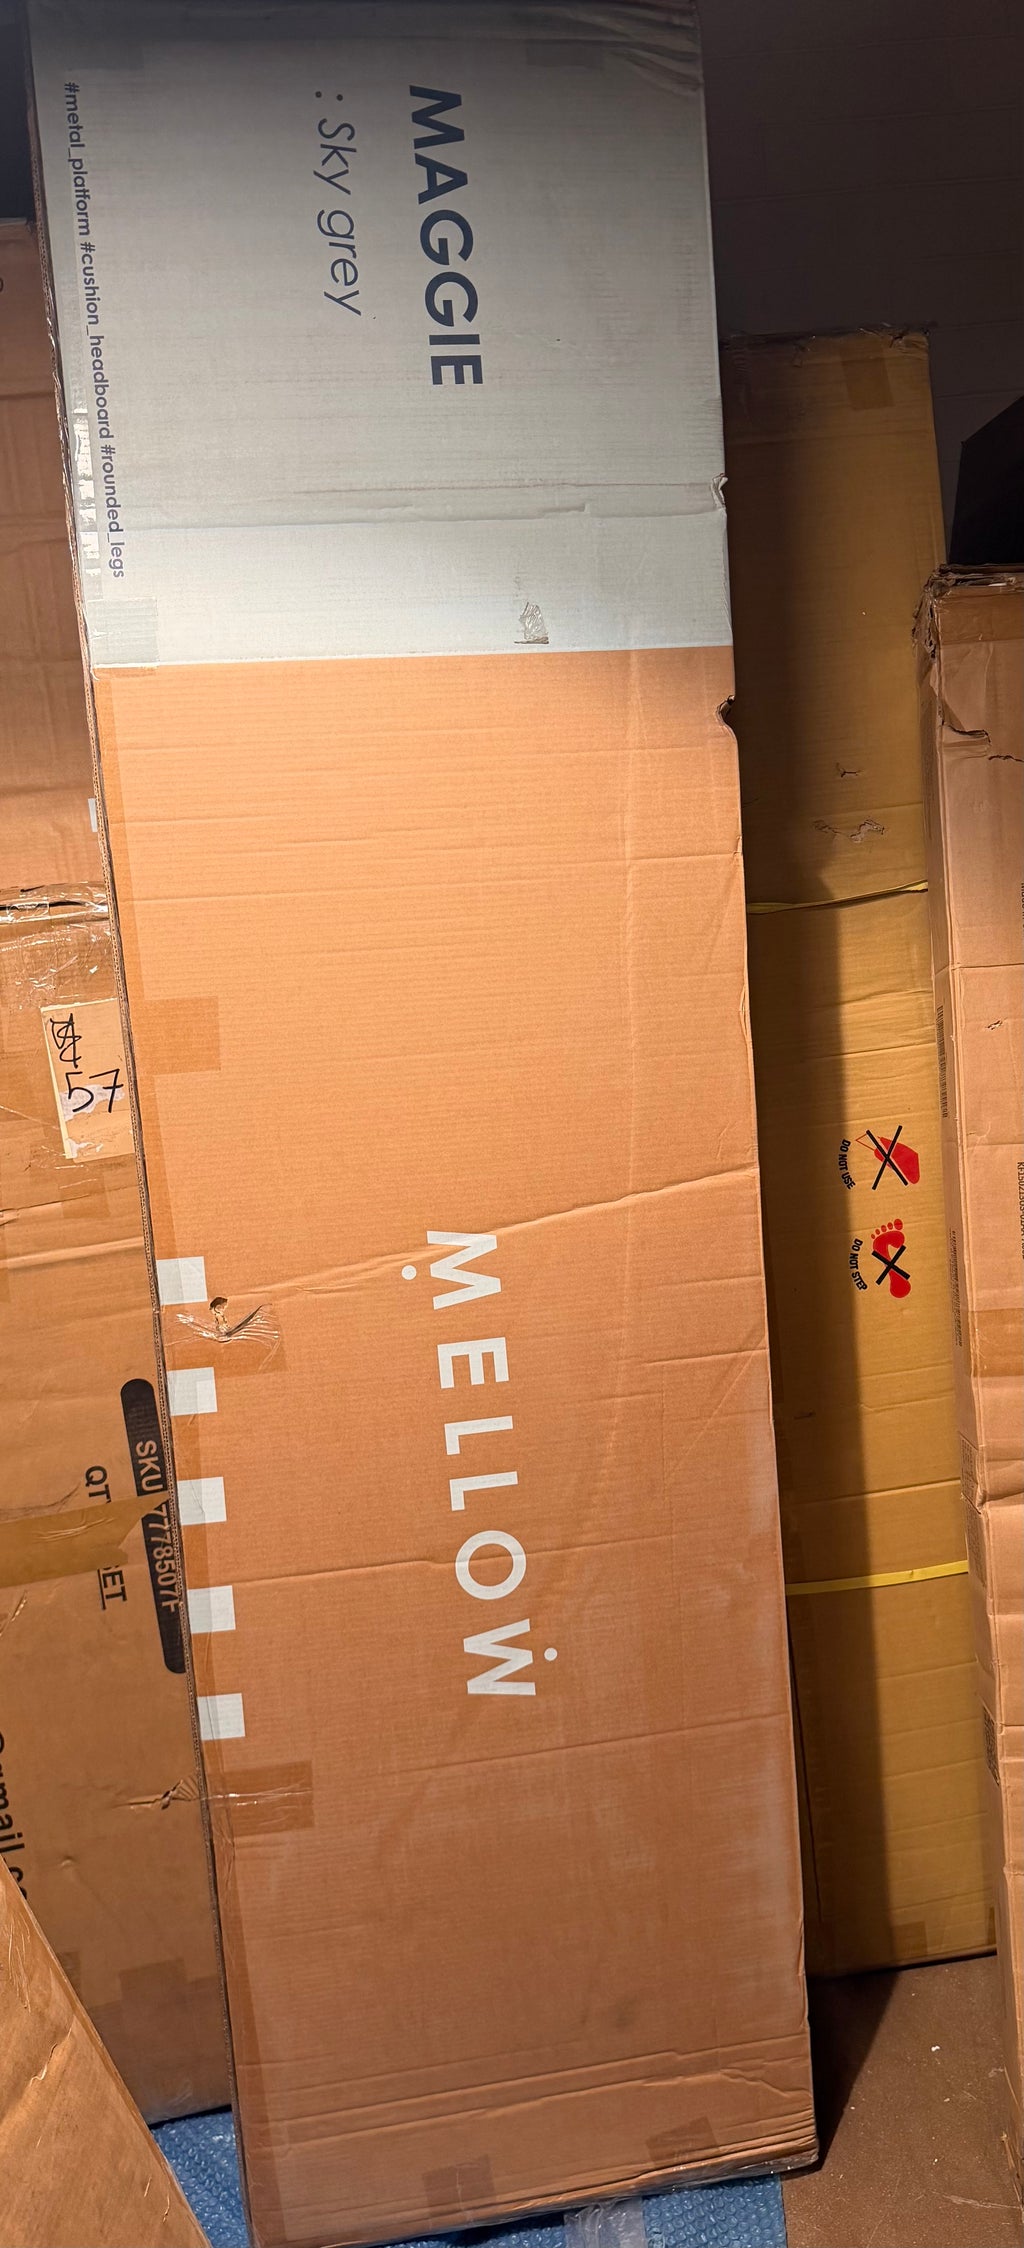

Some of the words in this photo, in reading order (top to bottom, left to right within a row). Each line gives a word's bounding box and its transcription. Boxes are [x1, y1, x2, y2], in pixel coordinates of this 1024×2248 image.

[312, 117, 358, 196] Sky
[409, 84, 484, 386] MAGGIE
[316, 209, 362, 316] grey
[63, 81, 91, 237] #metal_platform
[80, 241, 115, 439] #cushion_headboard
[100, 444, 125, 579] #rounded_legs
[838, 1153, 849, 1173] NOT
[840, 1138, 851, 1153] DO
[841, 1170, 857, 1190] USE
[849, 1252, 859, 1271] NOT
[851, 1238, 864, 1252] DO
[851, 1271, 868, 1291] STEP
[135, 1440, 164, 1492] SKU
[402, 1230, 558, 1696] MELLOW
[84, 1465, 112, 1504] QT
[102, 1565, 127, 1602] ET
